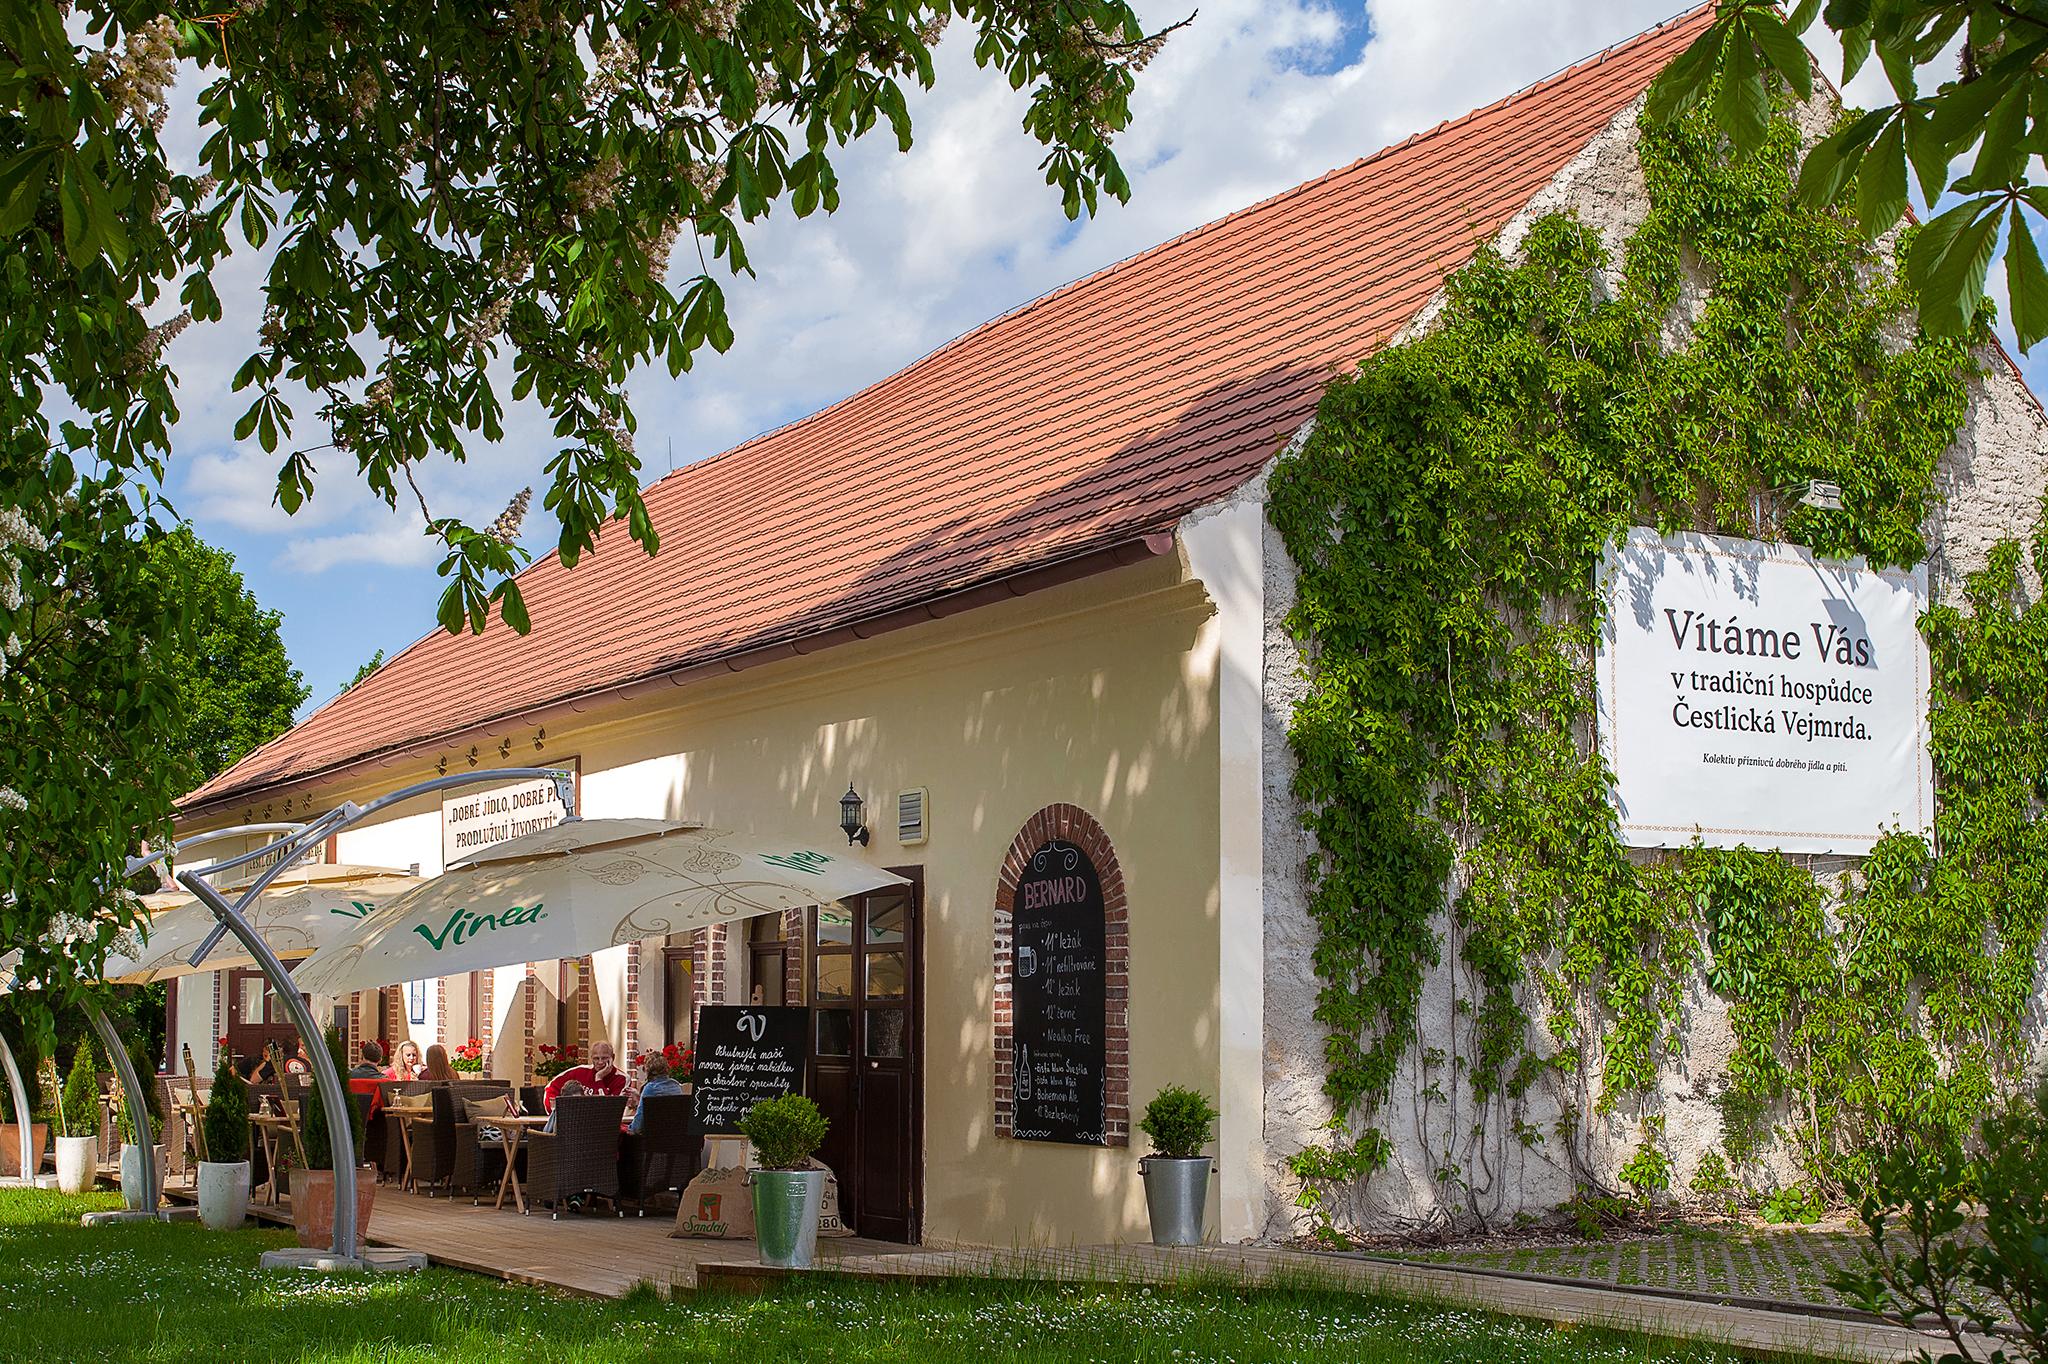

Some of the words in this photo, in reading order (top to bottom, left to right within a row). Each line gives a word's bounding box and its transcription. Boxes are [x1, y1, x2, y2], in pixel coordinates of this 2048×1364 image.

[1664, 608, 1800, 660] Vítáme
[1811, 623, 1870, 666] Vás
[1671, 672, 1685, 689] v
[1690, 670, 1774, 696] tradiční
[1781, 674, 1873, 705] hospůdce
[1673, 695, 1775, 733] Čestlická
[1781, 710, 1872, 742] Vejmrda.
[1703, 753, 1736, 765] Kolektiv
[1737, 756, 1774, 768] příznivců
[1775, 758, 1807, 770] dobrého
[1807, 760, 1825, 772] jídla
[482, 796, 511, 815] JÍDLO,
[513, 784, 544, 810] DOBRÉ
[456, 820, 508, 848] PRODLUŽUJÍ
[1024, 876, 1087, 910] BERNARD
[413, 903, 544, 950] Vinea
[1060, 930, 1081, 949] ležák
[715, 1045, 757, 1062] Ochutnejte
[760, 1047, 784, 1060] naši
[757, 1061, 794, 1072] nabídku
